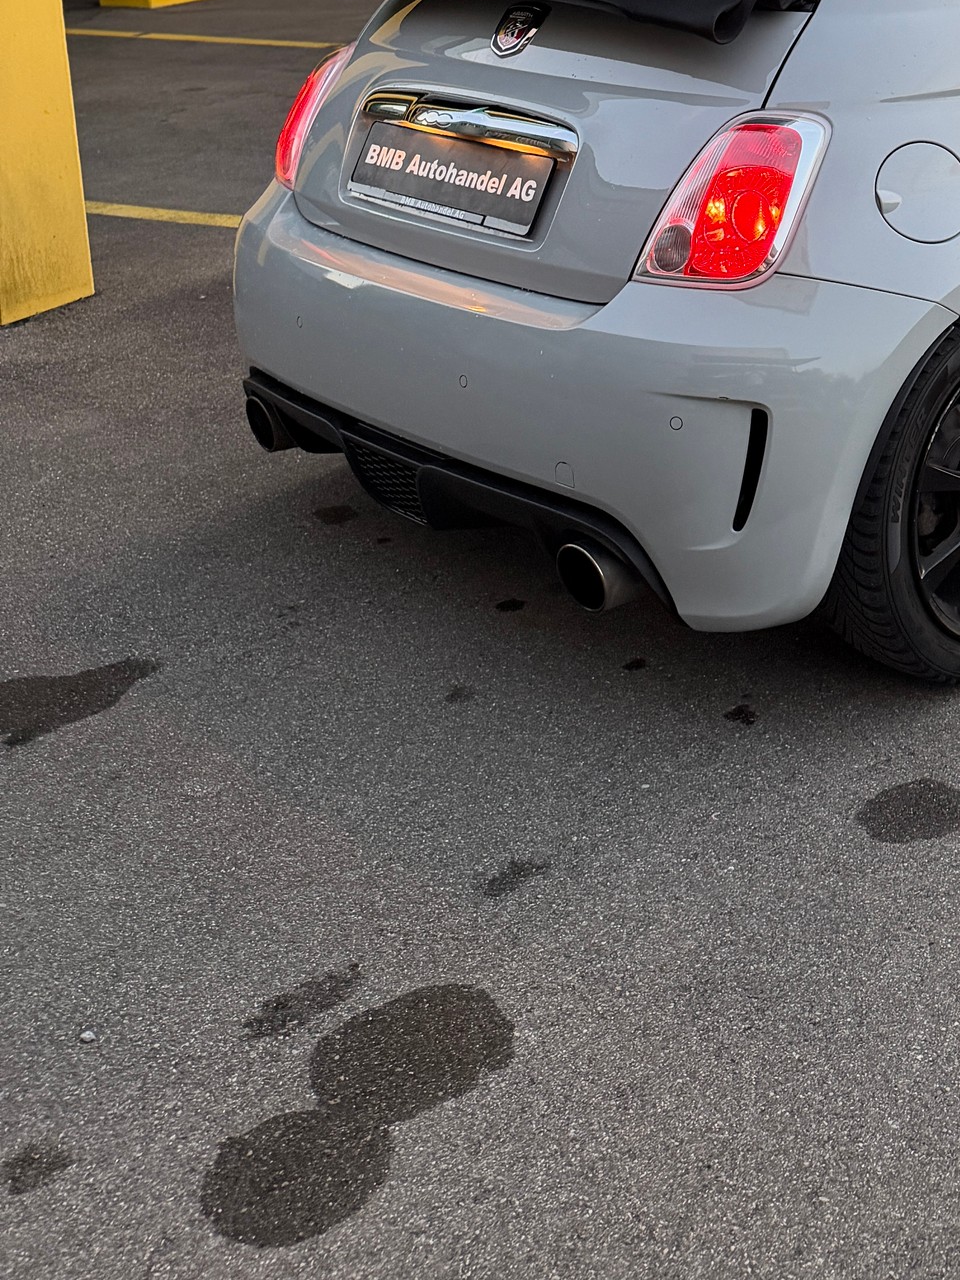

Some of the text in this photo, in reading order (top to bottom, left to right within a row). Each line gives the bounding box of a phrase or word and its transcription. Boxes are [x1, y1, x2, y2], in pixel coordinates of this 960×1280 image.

[365, 144, 537, 202] BMB Autohandel AG
[400, 195, 465, 219] BMB Autohandel AG
